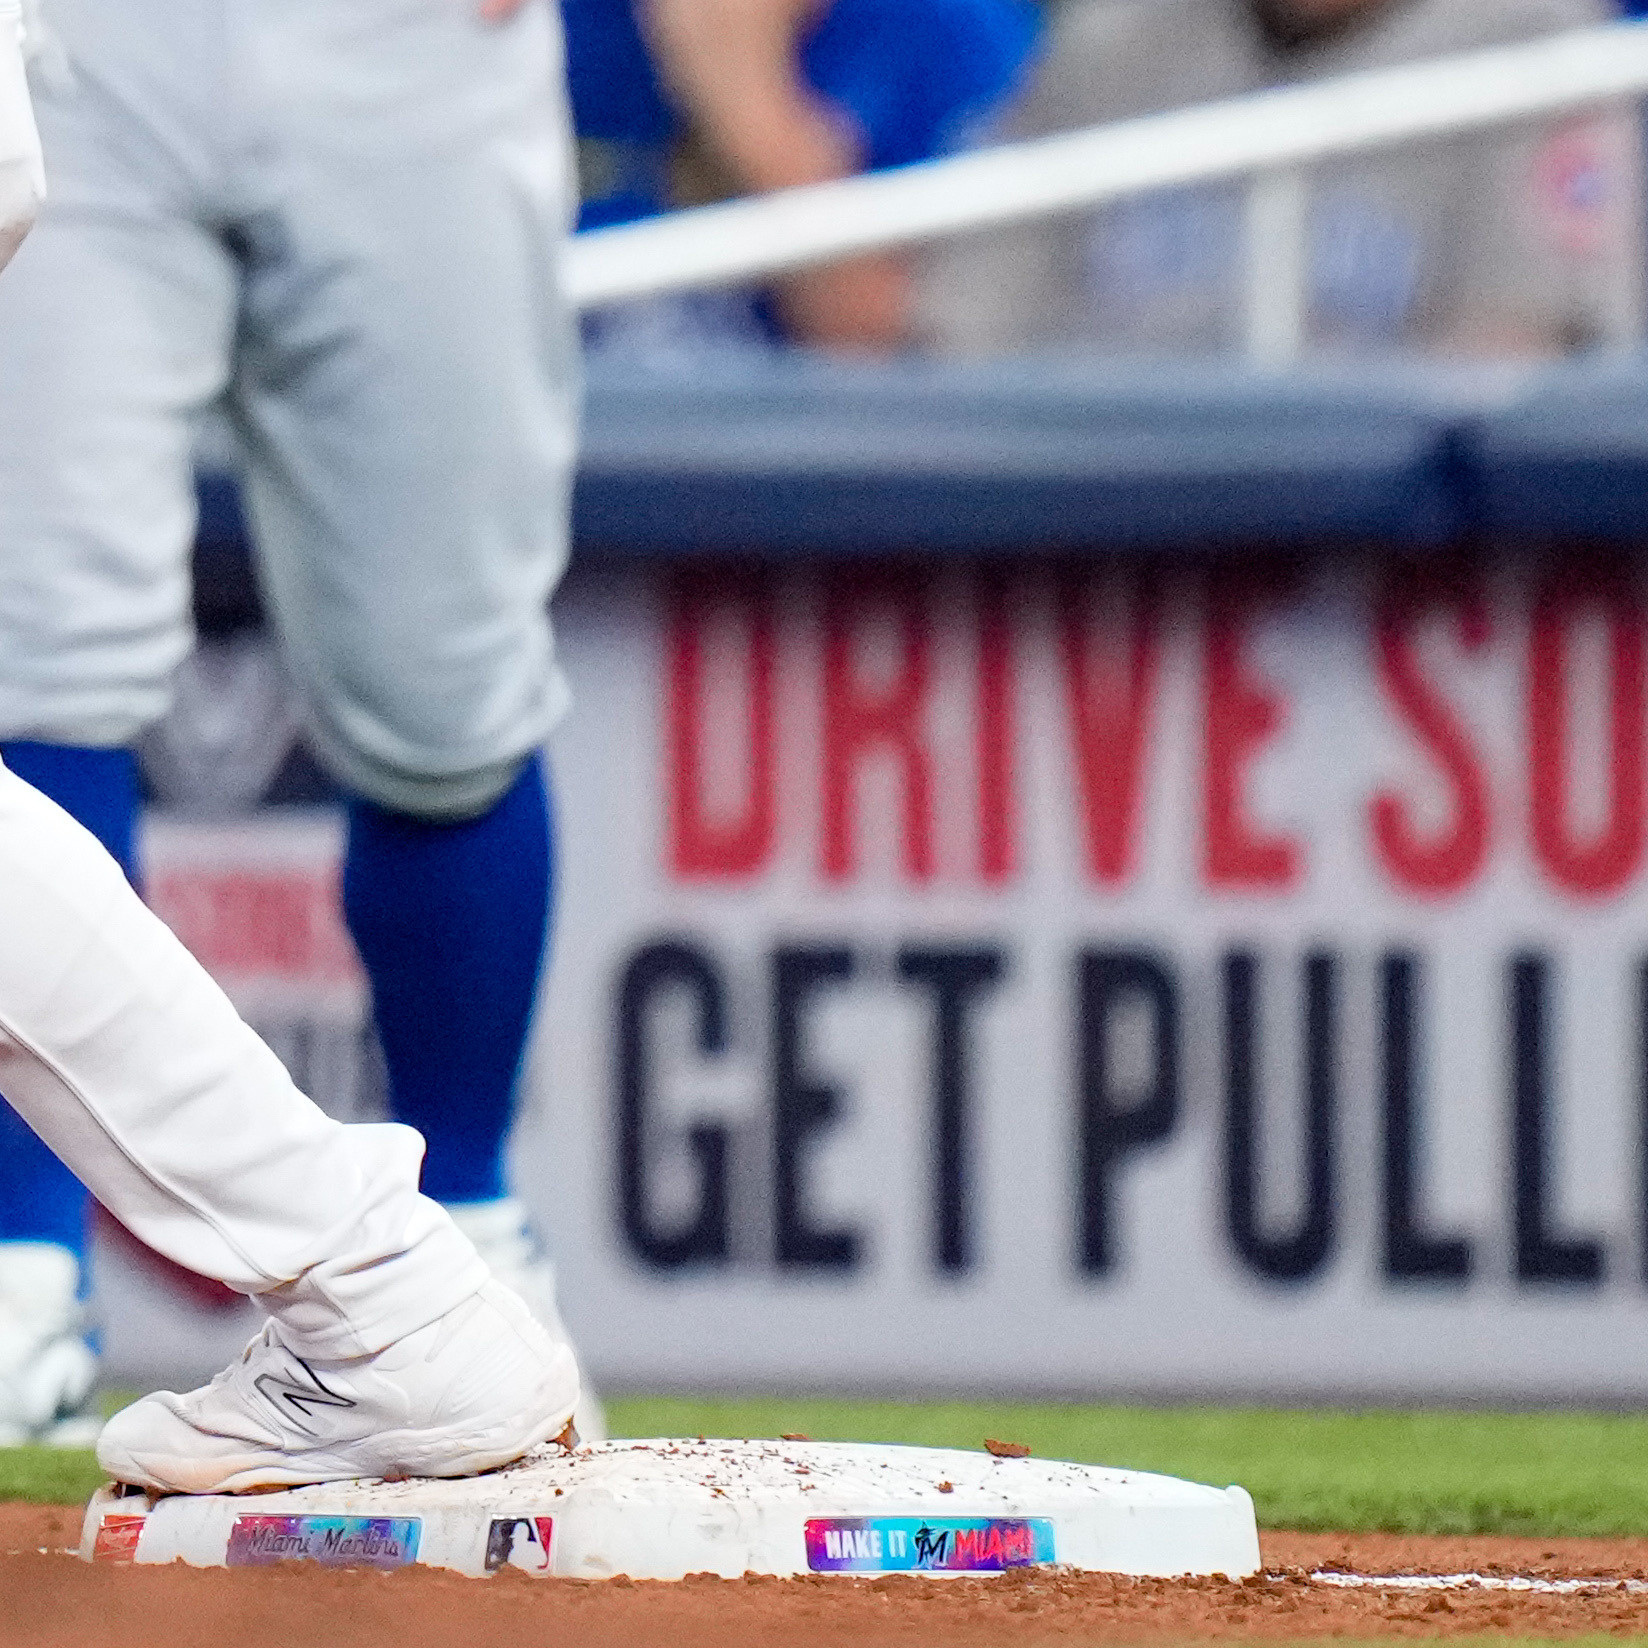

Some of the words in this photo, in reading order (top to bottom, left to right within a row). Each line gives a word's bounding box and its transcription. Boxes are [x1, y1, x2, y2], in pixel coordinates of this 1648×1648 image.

[659, 557, 1312, 890] DRIVE
[614, 934, 1014, 1277] GET
[1074, 940, 1648, 1284] PULL
[248, 1525, 310, 1555] Miami
[824, 1529, 882, 1560] MAKE
[888, 1529, 908, 1559] IT
[954, 1526, 1035, 1562] MIAMI
